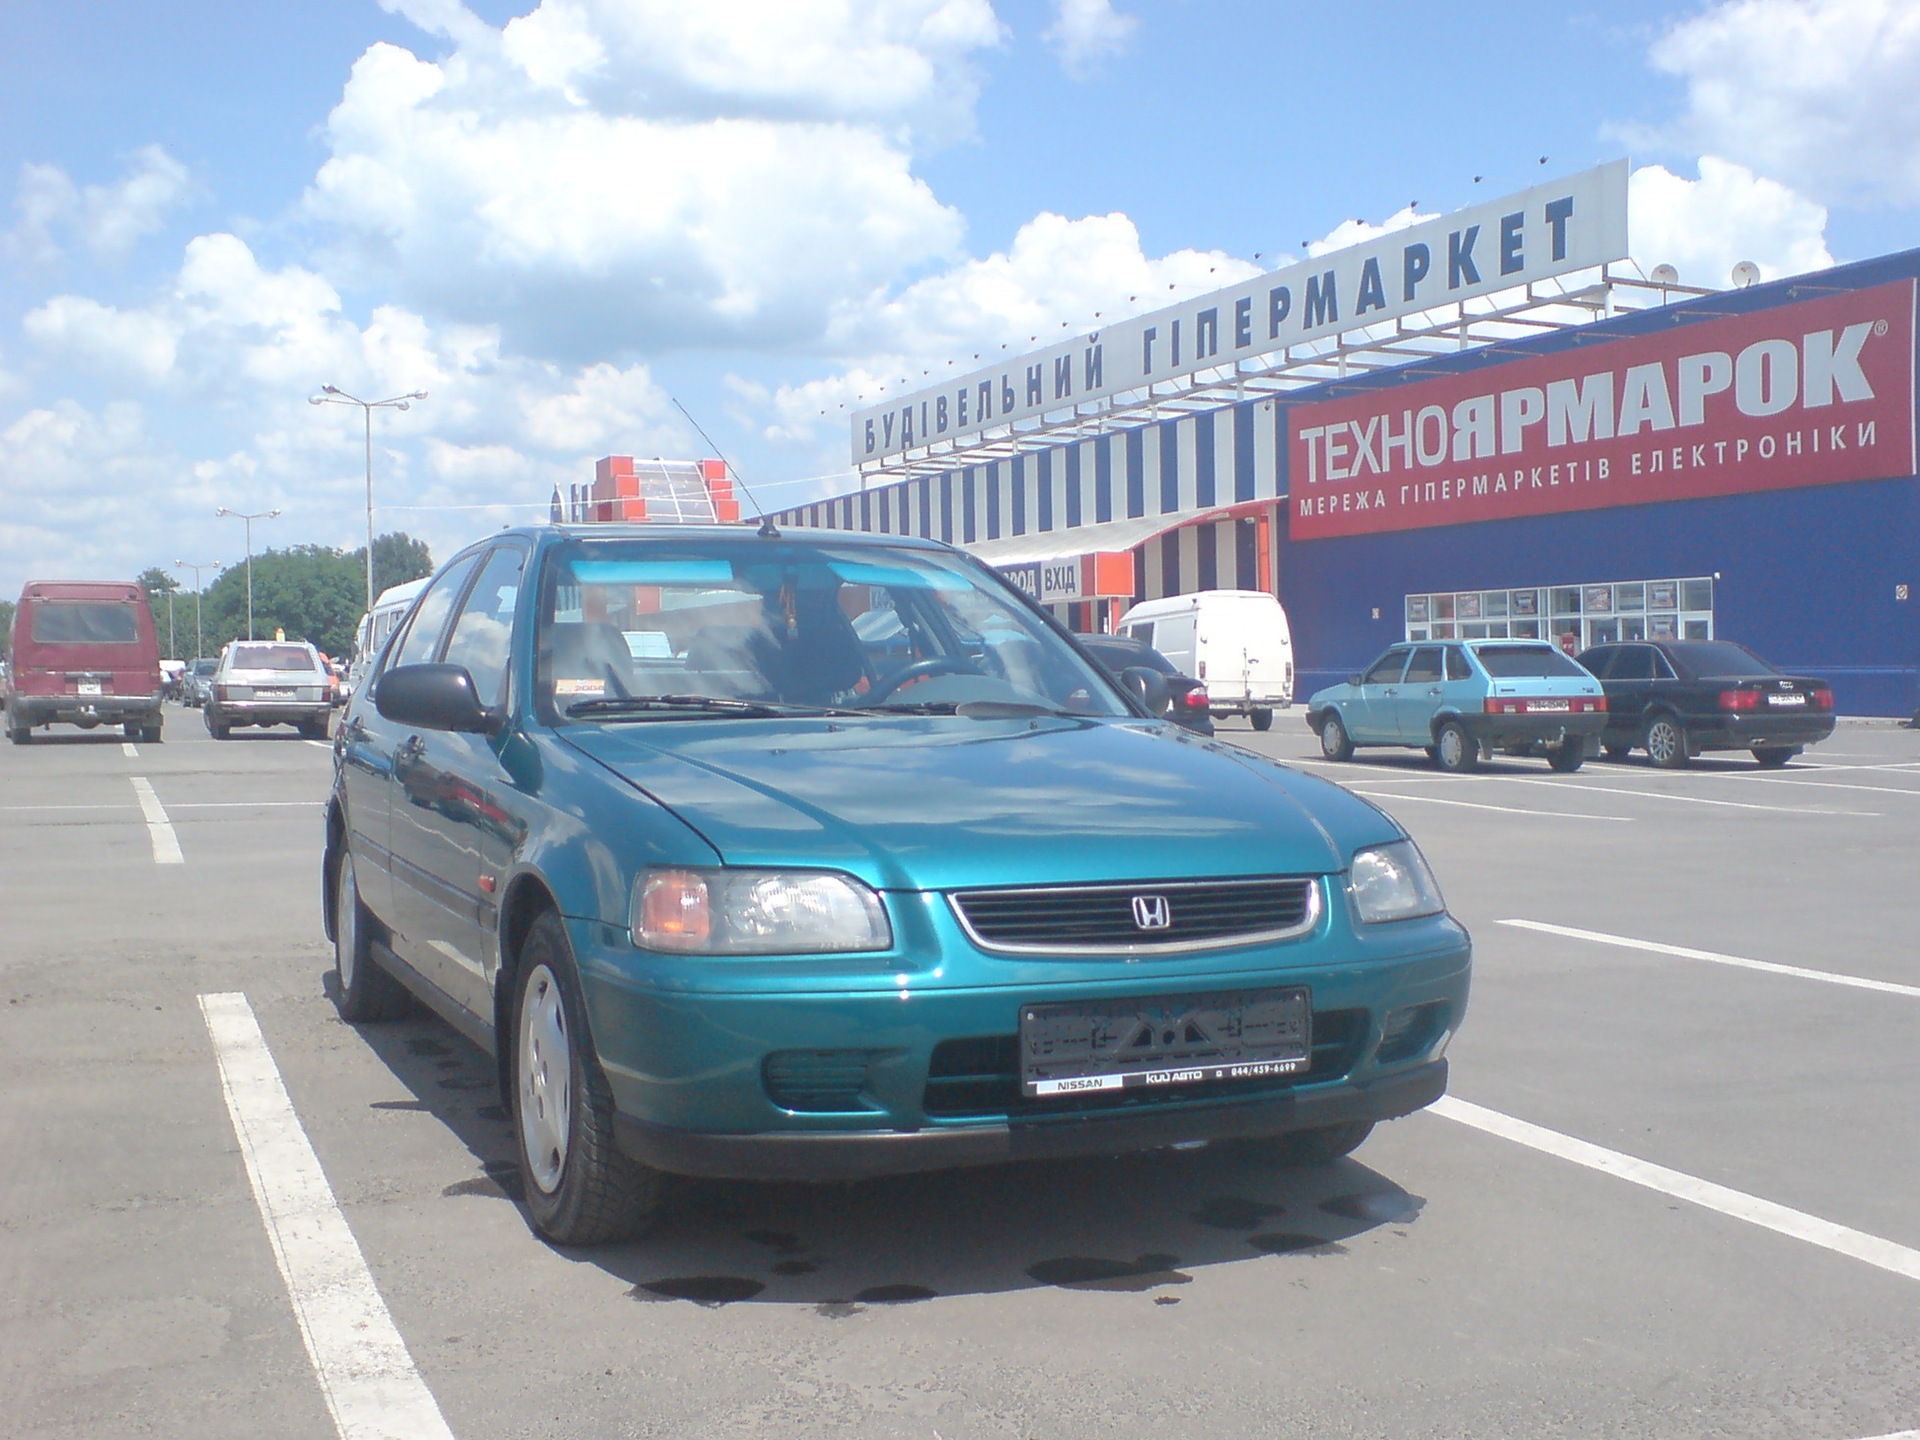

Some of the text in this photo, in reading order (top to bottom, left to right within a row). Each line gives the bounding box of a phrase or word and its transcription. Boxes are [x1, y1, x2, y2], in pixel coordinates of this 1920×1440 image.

[864, 195, 1575, 454] БУДІВЕЛЬНИЙ ГІПЕРМАРКЕТ
[1299, 320, 1876, 483] ТЕХНОЯРМАРОК
[1299, 421, 1878, 517] МЕРЕЖА ГІПЕРМАРКЕТІВ ЕЛЕКТРОНІКИ
[1044, 565, 1076, 593] ВХІД
[1057, 1078, 1103, 1091] NISSAN
